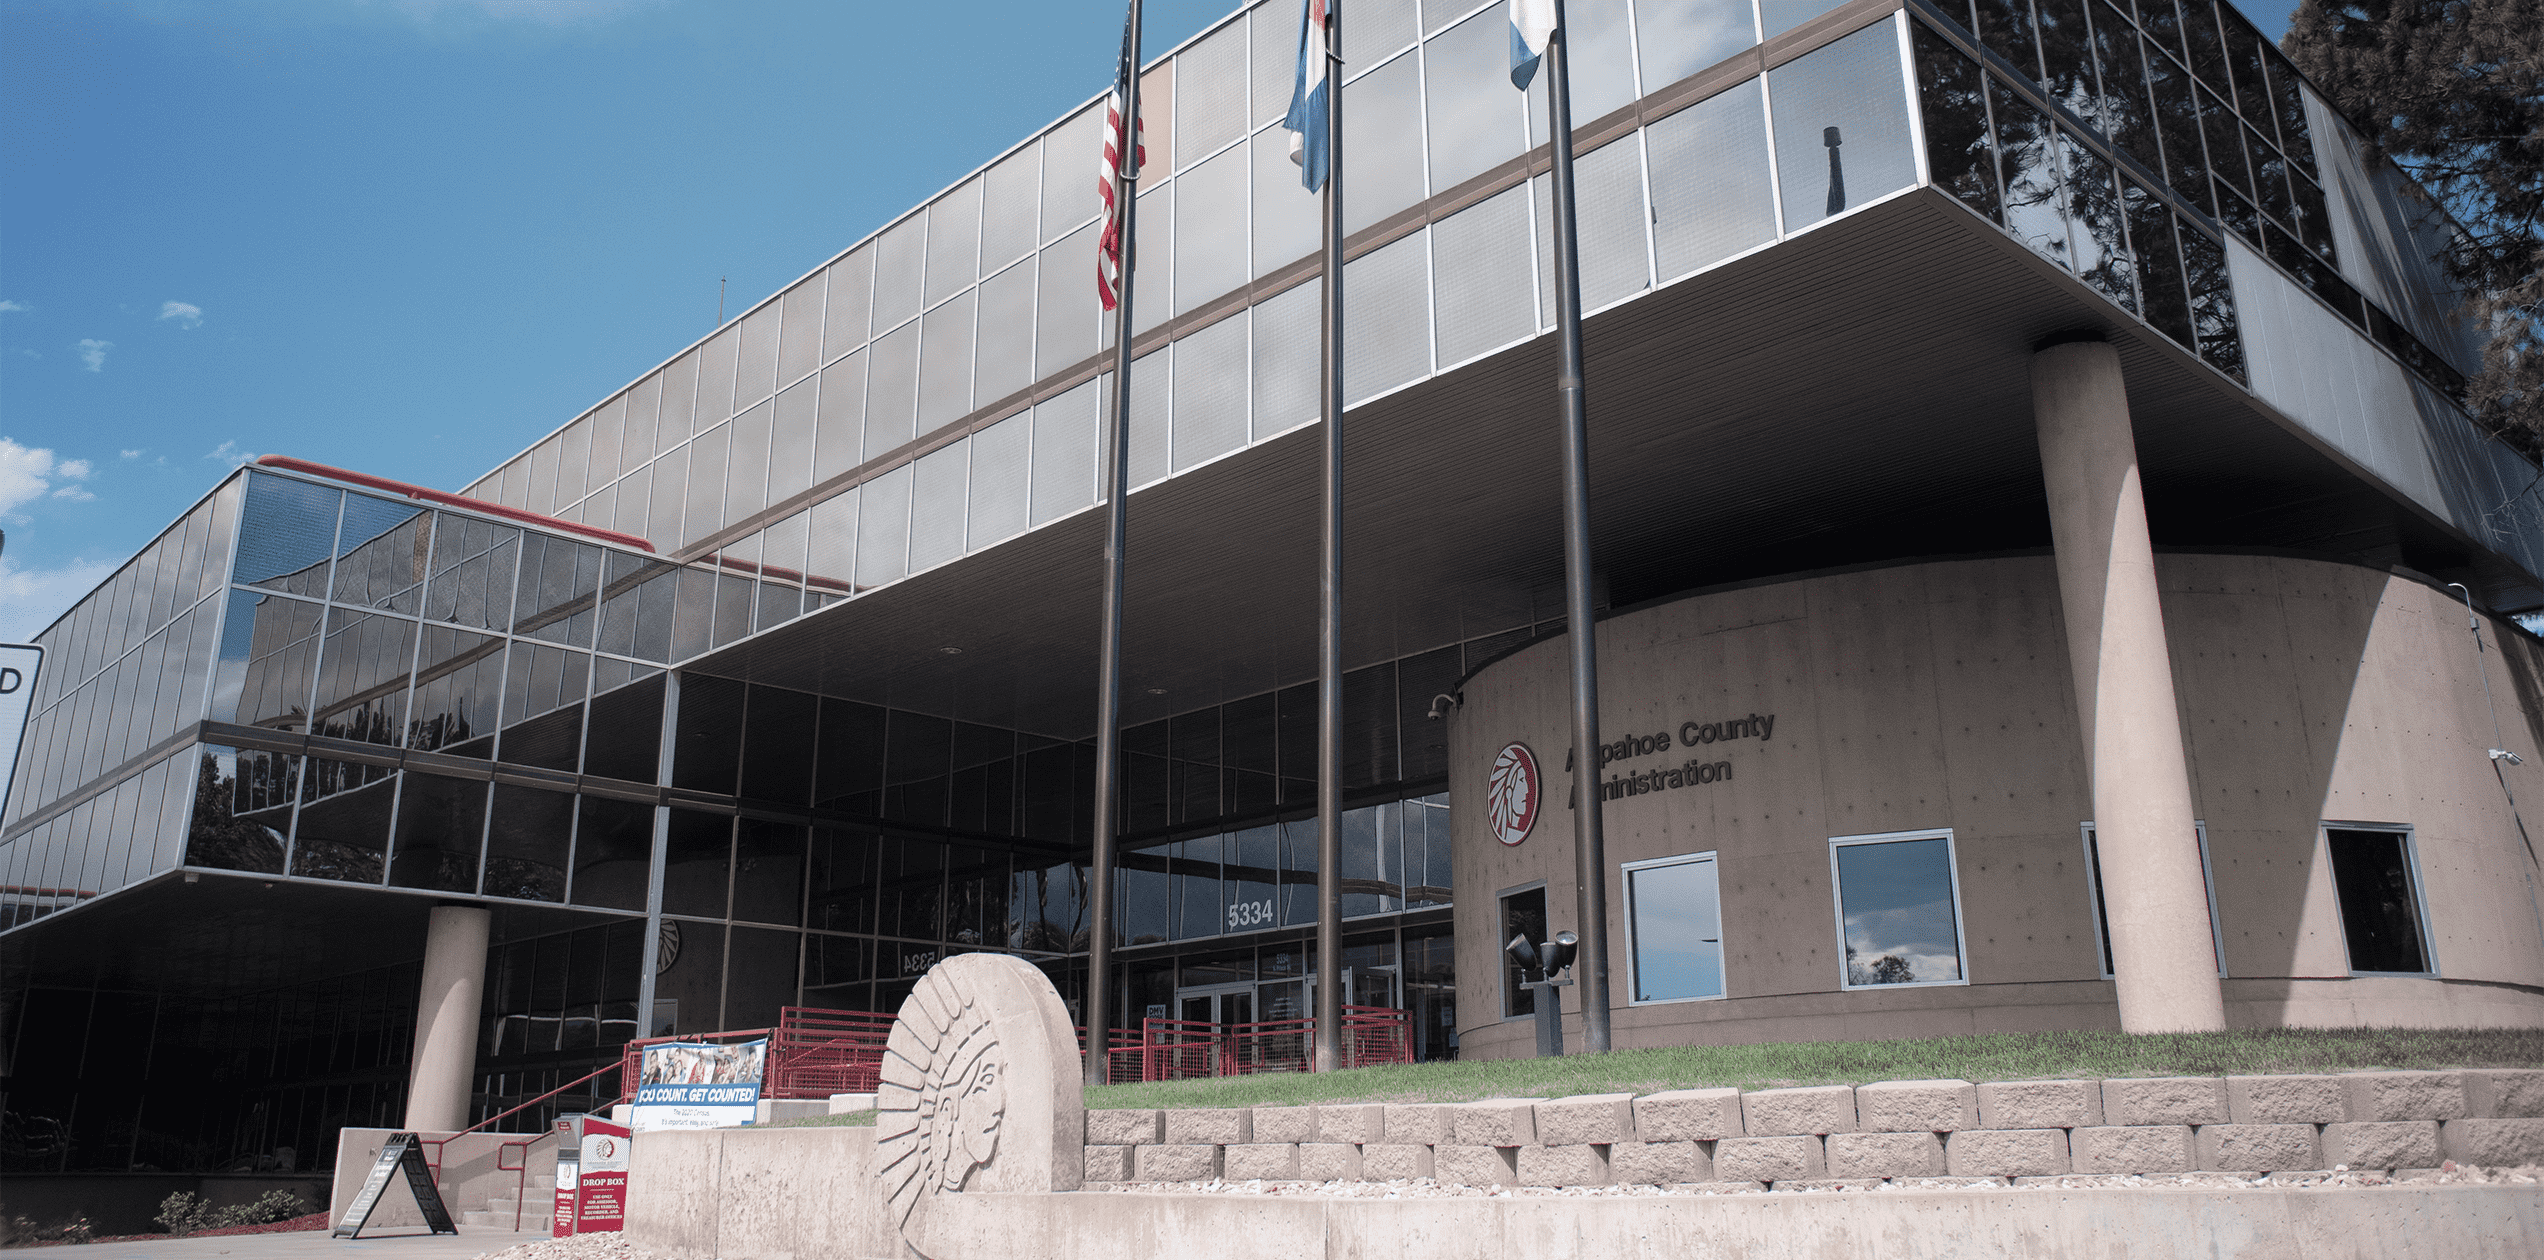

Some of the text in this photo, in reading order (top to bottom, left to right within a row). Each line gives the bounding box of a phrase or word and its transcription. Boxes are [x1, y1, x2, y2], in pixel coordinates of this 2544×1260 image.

[1565, 712, 1775, 772] pahoe County
[1568, 758, 1732, 809] ministration
[1228, 899, 1273, 927] 5334
[1149, 1006, 1164, 1015] DMV
[656, 1088, 688, 1102] COUNT.
[689, 1088, 708, 1102] GET
[708, 1088, 756, 1102] COUNTED!
[582, 1178, 606, 1186] DROP
[606, 1178, 625, 1186] BOX
